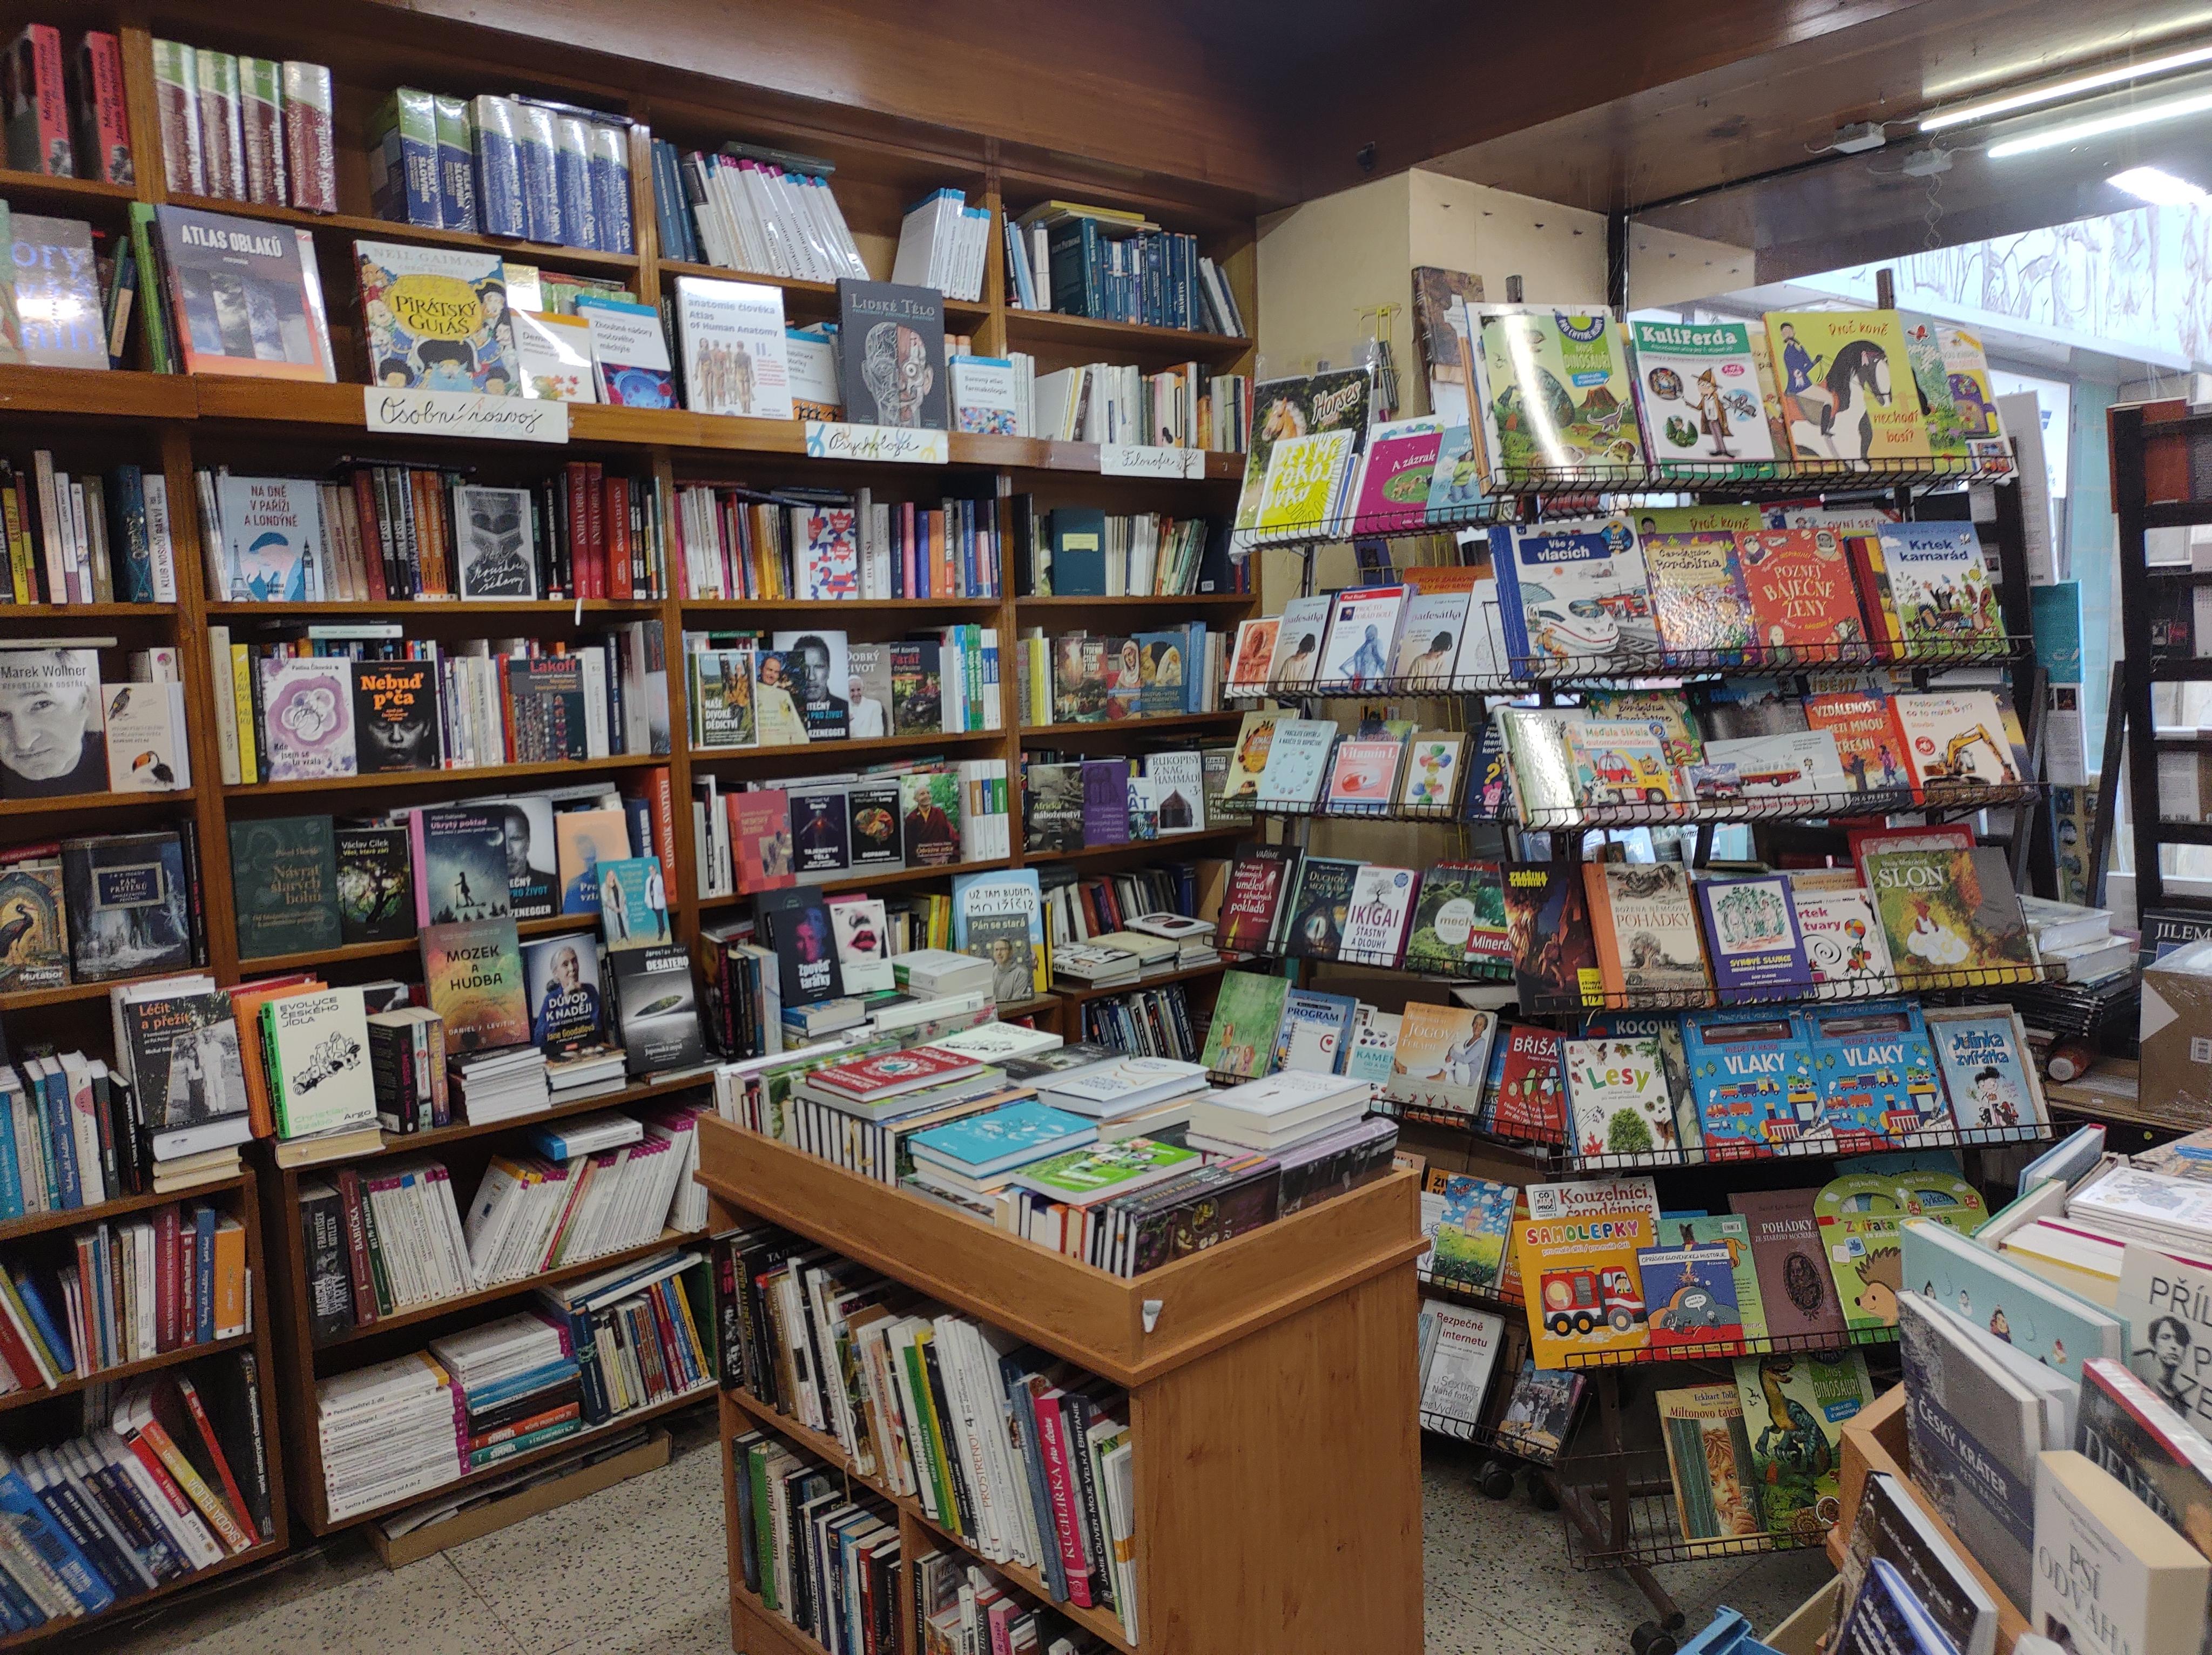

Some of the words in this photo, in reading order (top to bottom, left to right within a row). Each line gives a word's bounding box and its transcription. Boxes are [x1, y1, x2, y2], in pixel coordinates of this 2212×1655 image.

[181, 225, 227, 251] ATLAS
[230, 233, 281, 258] OBLAKŮ
[395, 294, 478, 319] PIRÁTSKÝ
[689, 310, 714, 321] Atlas
[408, 314, 470, 335] GULÁŠ
[1829, 320, 1855, 336] Proč
[1860, 321, 1889, 336] koně
[1640, 326, 1737, 345] KuliFerda
[1311, 380, 1362, 425] Horses
[1874, 410, 1919, 425] nechodí
[1391, 459, 1401, 472] A
[1402, 450, 1436, 468] zázrak
[250, 484, 264, 498] NA
[267, 483, 286, 498] DNĚ
[249, 500, 257, 512] V
[244, 515, 252, 526] A
[1548, 539, 1566, 549] Vše
[1910, 539, 1954, 551] Krtek
[1537, 545, 1590, 561] vlacích
[1900, 551, 1968, 563] kamarád
[1773, 563, 1822, 580] POZNEJ
[1762, 578, 1835, 603] BÁJEČNÉ
[1786, 599, 1825, 619] ŽENY
[1, 666, 39, 679] Marek
[43, 664, 87, 677] Wollner
[530, 658, 576, 673] Lakoff
[849, 663, 876, 673] IVOT
[360, 672, 424, 691] Nebuď
[705, 699, 723, 709] NAŠE
[1813, 700, 1878, 718] VZDÁLENOST
[706, 708, 732, 719] DIVOKÉ
[706, 718, 738, 730] DĚDICTVÍ
[1850, 718, 1884, 733] MNOU
[1152, 755, 1201, 767] RUKOPISY
[1154, 766, 1161, 775] Z
[1163, 765, 1183, 775] NAG
[1154, 772, 1201, 786] HAMMÁDÍ
[1034, 809, 1081, 820] náboženství
[1877, 864, 1944, 889] SLON
[969, 888, 983, 899] UŽ
[985, 889, 1001, 898] TAM
[1230, 900, 1265, 914] pokladů
[1798, 907, 1828, 920] rtek
[972, 920, 991, 931] Pán
[1002, 917, 1026, 929] stará
[1350, 905, 1399, 927] IKIGAI
[1616, 913, 1690, 928] POHÁDKY
[1356, 926, 1387, 938] ŠŤASTNÝ
[1803, 920, 1841, 932] tvary
[1351, 938, 1356, 947] A
[1358, 938, 1387, 949] DLOUHÝ
[446, 944, 500, 963] MOZEK
[1763, 954, 1792, 964] SLUNCE
[471, 963, 478, 973] A
[646, 955, 689, 971] DESATERO
[20, 971, 64, 982] Mutabor
[450, 973, 503, 991] HUDBA
[279, 996, 337, 1012] EVOLUCE
[549, 991, 588, 1009] DŮVOD
[138, 1002, 172, 1017] Léčit
[280, 1003, 339, 1019] ČESKÉHO
[545, 1011, 554, 1022] K
[555, 1002, 592, 1021] NADĚJI
[1287, 1006, 1339, 1022] PROGRAM
[140, 1021, 149, 1030] a
[153, 1011, 191, 1031] přežít
[282, 1015, 315, 1028] JÍDLA
[1723, 1053, 1785, 1075] VLAKY
[1842, 1044, 1904, 1068] VLAKY
[1586, 1066, 1650, 1093] Lesy
[294, 1106, 348, 1122] Christian
[343, 1109, 371, 1121] Argo
[294, 1118, 333, 1131] Szabo
[1559, 1184, 1653, 1205] Kouzelníci,
[350, 1206, 364, 1251] BABIČKA
[1526, 1220, 1640, 1246] SAMOLEPKY
[1762, 1219, 1813, 1234] POHÁDKY
[1844, 1219, 1896, 1233] Zvířata
[1789, 1231, 1819, 1240] MOCNÁŘST
[1542, 1248, 1554, 1257] pro
[1554, 1246, 1570, 1254] malé
[1570, 1244, 1582, 1253] děti
[1601, 1242, 1616, 1251] malé
[1617, 1241, 1630, 1249] deti
[1442, 1328, 1488, 1348] internetu
[1441, 1375, 1481, 1395] Sexting
[1432, 1384, 1453, 1397] Nahé
[1454, 1390, 1474, 1404] fotky
[1694, 1393, 1719, 1401] Eckhart
[1722, 1391, 1736, 1400] Tolle
[1434, 1400, 1474, 1420] Vydírání
[1670, 1406, 1715, 1418] Miltonovo
[1919, 1395, 1957, 1447] ČESKÝ
[1959, 1440, 2007, 1501] KRÁTER
[1053, 1466, 1076, 1559] KUCHAŘKA
[1098, 1553, 1110, 1587] JAMIE
[2069, 1542, 2101, 1602] PSÍ
